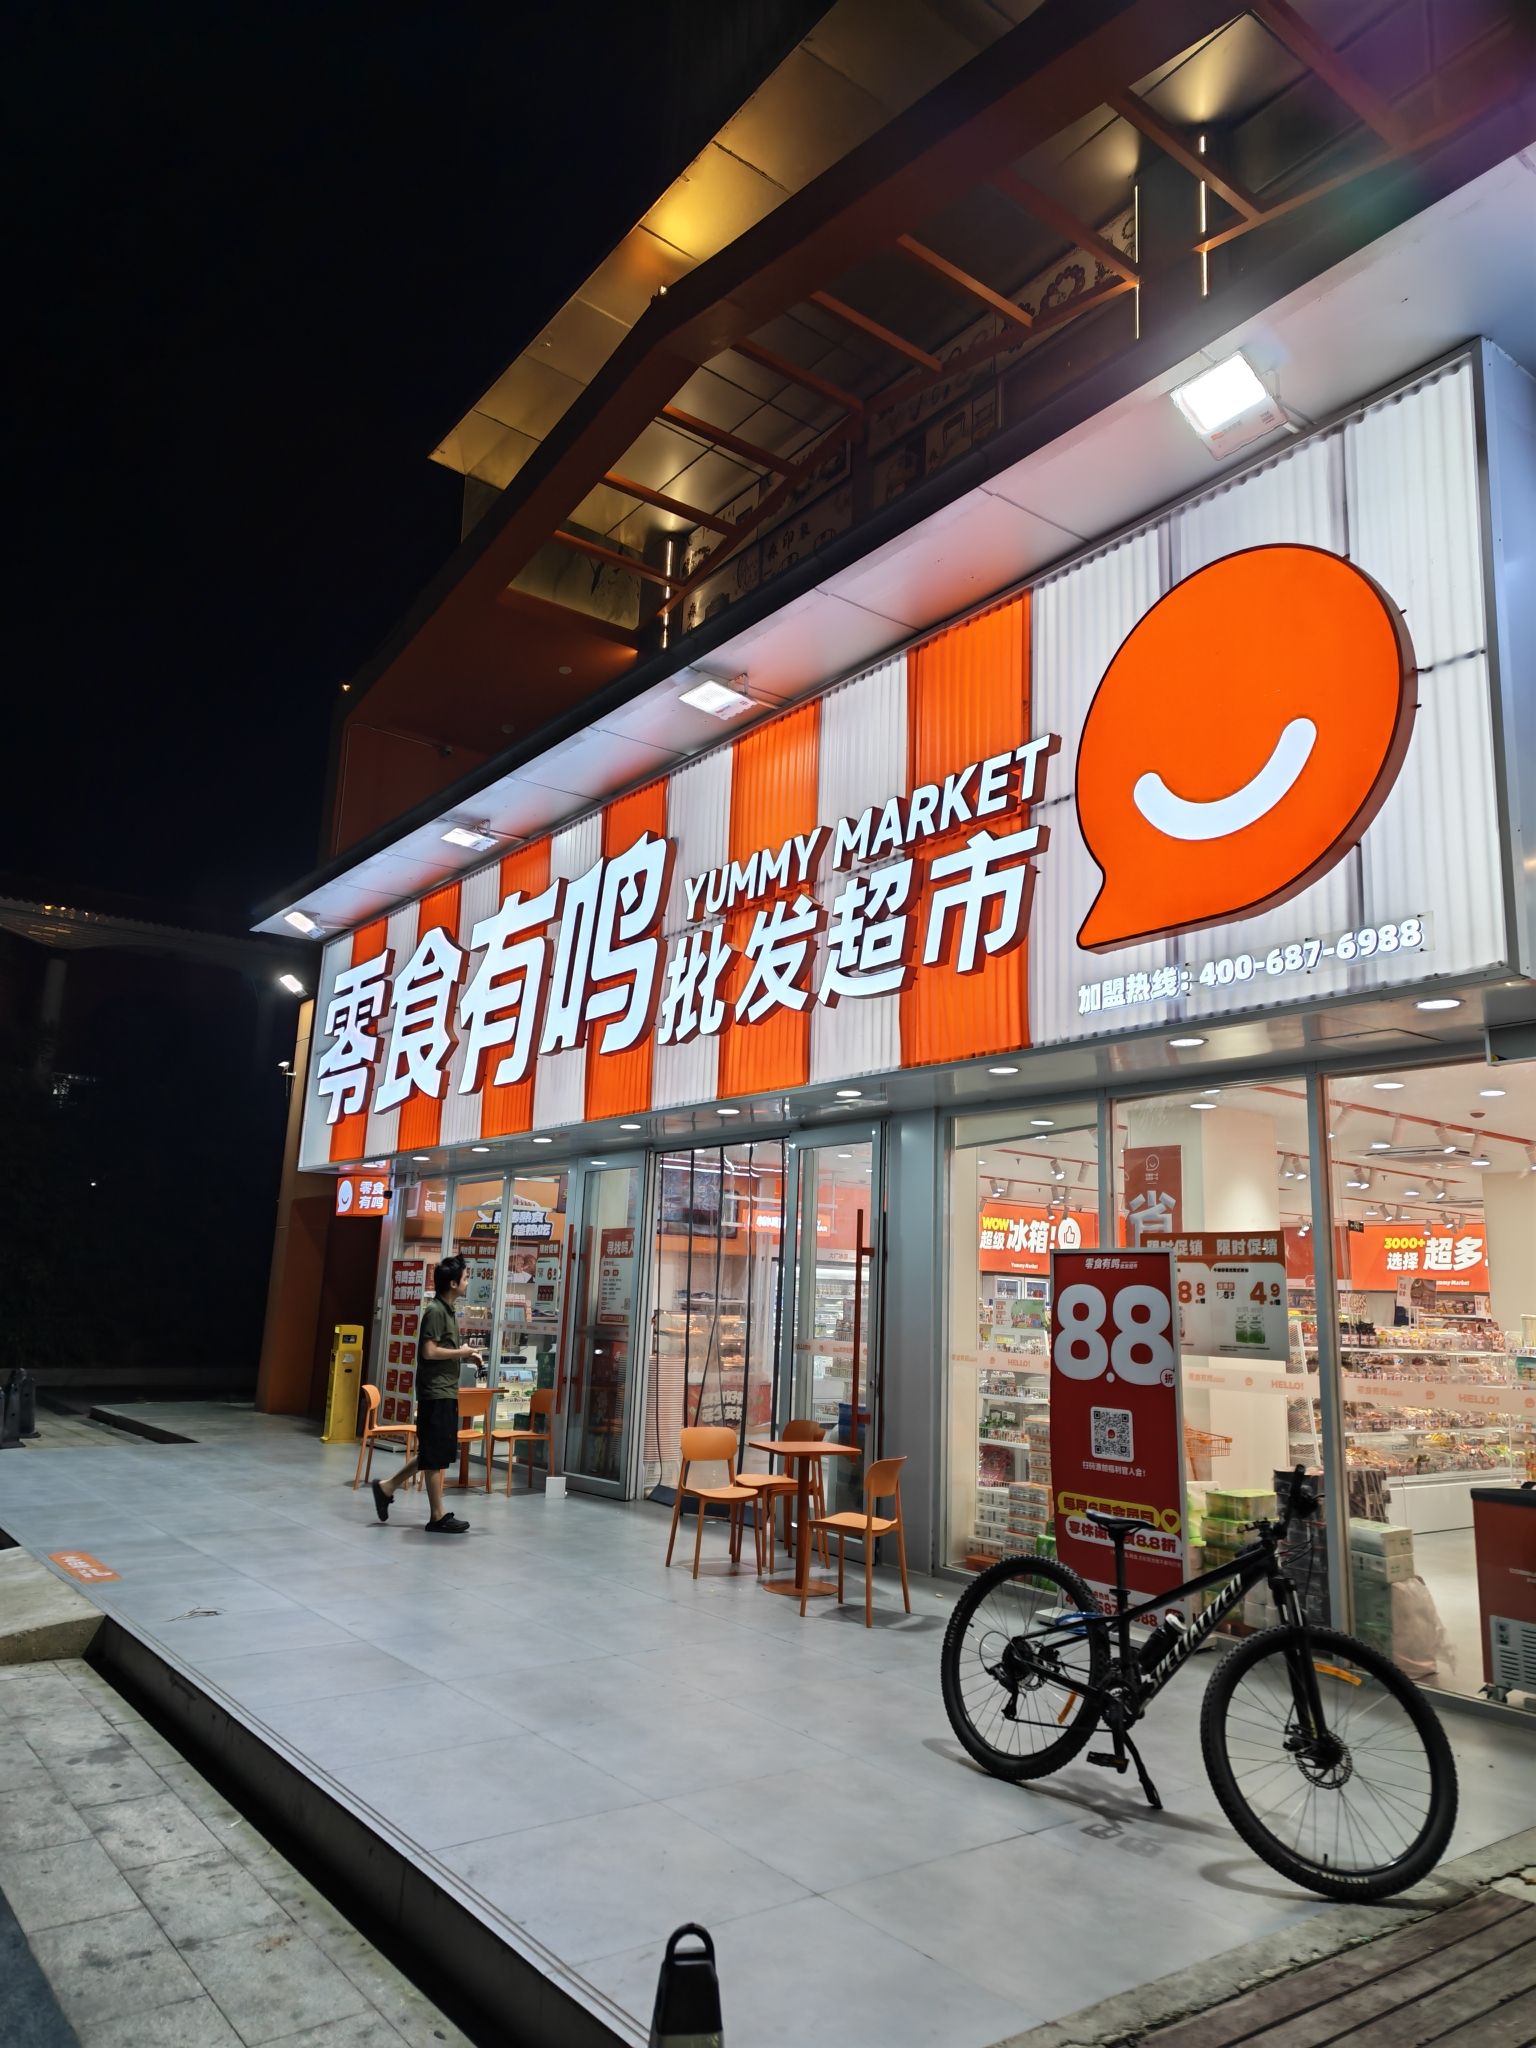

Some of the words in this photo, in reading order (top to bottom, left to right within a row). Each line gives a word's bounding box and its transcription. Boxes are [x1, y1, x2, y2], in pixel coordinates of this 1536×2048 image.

[684, 826, 831, 922] YUMMY
[832, 734, 1060, 870] MARKET
[658, 825, 1049, 1045] 批发超市
[1199, 918, 1423, 988] 400-687-6988
[317, 831, 674, 1125] 零食有鸣
[360, 1181, 385, 1195] 零食
[982, 1217, 1009, 1230] WOW
[980, 1231, 1005, 1250] 超级
[1007, 1218, 1056, 1254] 冰箱!
[1384, 1237, 1425, 1249] 3000+
[1216, 1238, 1278, 1256] 限时促销
[1423, 1236, 1487, 1271] 超多
[1387, 1252, 1419, 1271] 选择
[1054, 1284, 1175, 1386] 8.8
[1271, 1379, 1304, 1390] HELLO!
[1458, 1393, 1500, 1406] HELLO!
